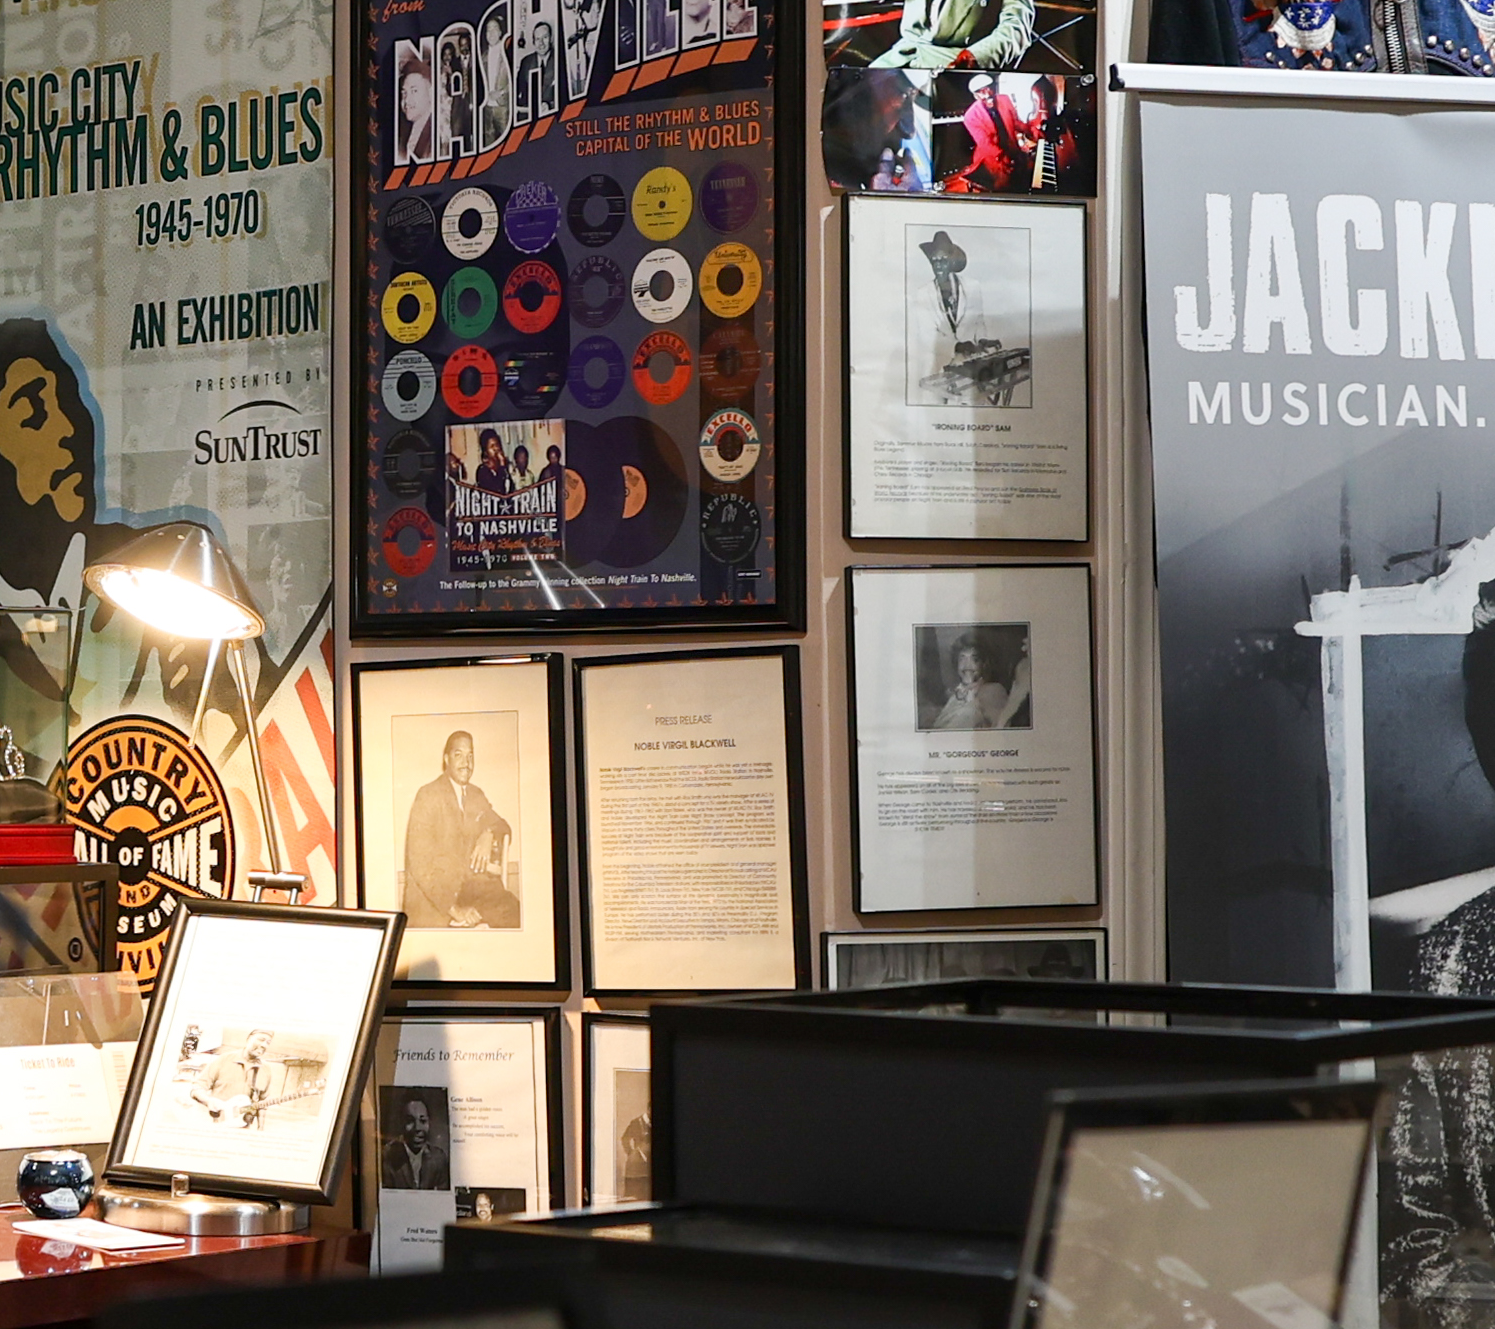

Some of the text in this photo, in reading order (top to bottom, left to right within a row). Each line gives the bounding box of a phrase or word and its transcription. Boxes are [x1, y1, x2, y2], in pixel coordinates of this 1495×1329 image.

[69, 59, 143, 133] CITY
[159, 109, 190, 182] &
[200, 86, 327, 176] BLUES
[565, 100, 761, 139] STILL THE RHYTHM & BLUES
[575, 121, 763, 158] CAPITAL OF THE WORLD
[135, 186, 262, 248] 1945-1970
[130, 281, 322, 351] AN EXHIBITION
[1186, 380, 1488, 429] MUSICIAN.
[707, 412, 753, 437] EXCELLO
[454, 480, 557, 517] NIGHT TRAIN
[702, 492, 759, 521] REPUBLIC
[456, 518, 559, 537] TO NASHVILLE
[607, 573, 698, 585] Night Train To Nashville.
[654, 714, 713, 726] PRESS RELEASE
[634, 738, 737, 751] NOBLE VIRGIL BLACKWELL
[942, 750, 989, 758] "GORGEOUS"
[989, 749, 1020, 757] GEORGE
[65, 737, 207, 808] COUNTRY
[86, 776, 178, 823] MUSIC
[118, 816, 222, 899] OF FAME
[116, 892, 178, 935] SEUM
[19, 1056, 76, 1070] Ticket To Ride
[392, 1048, 515, 1064] Friends to Remember
